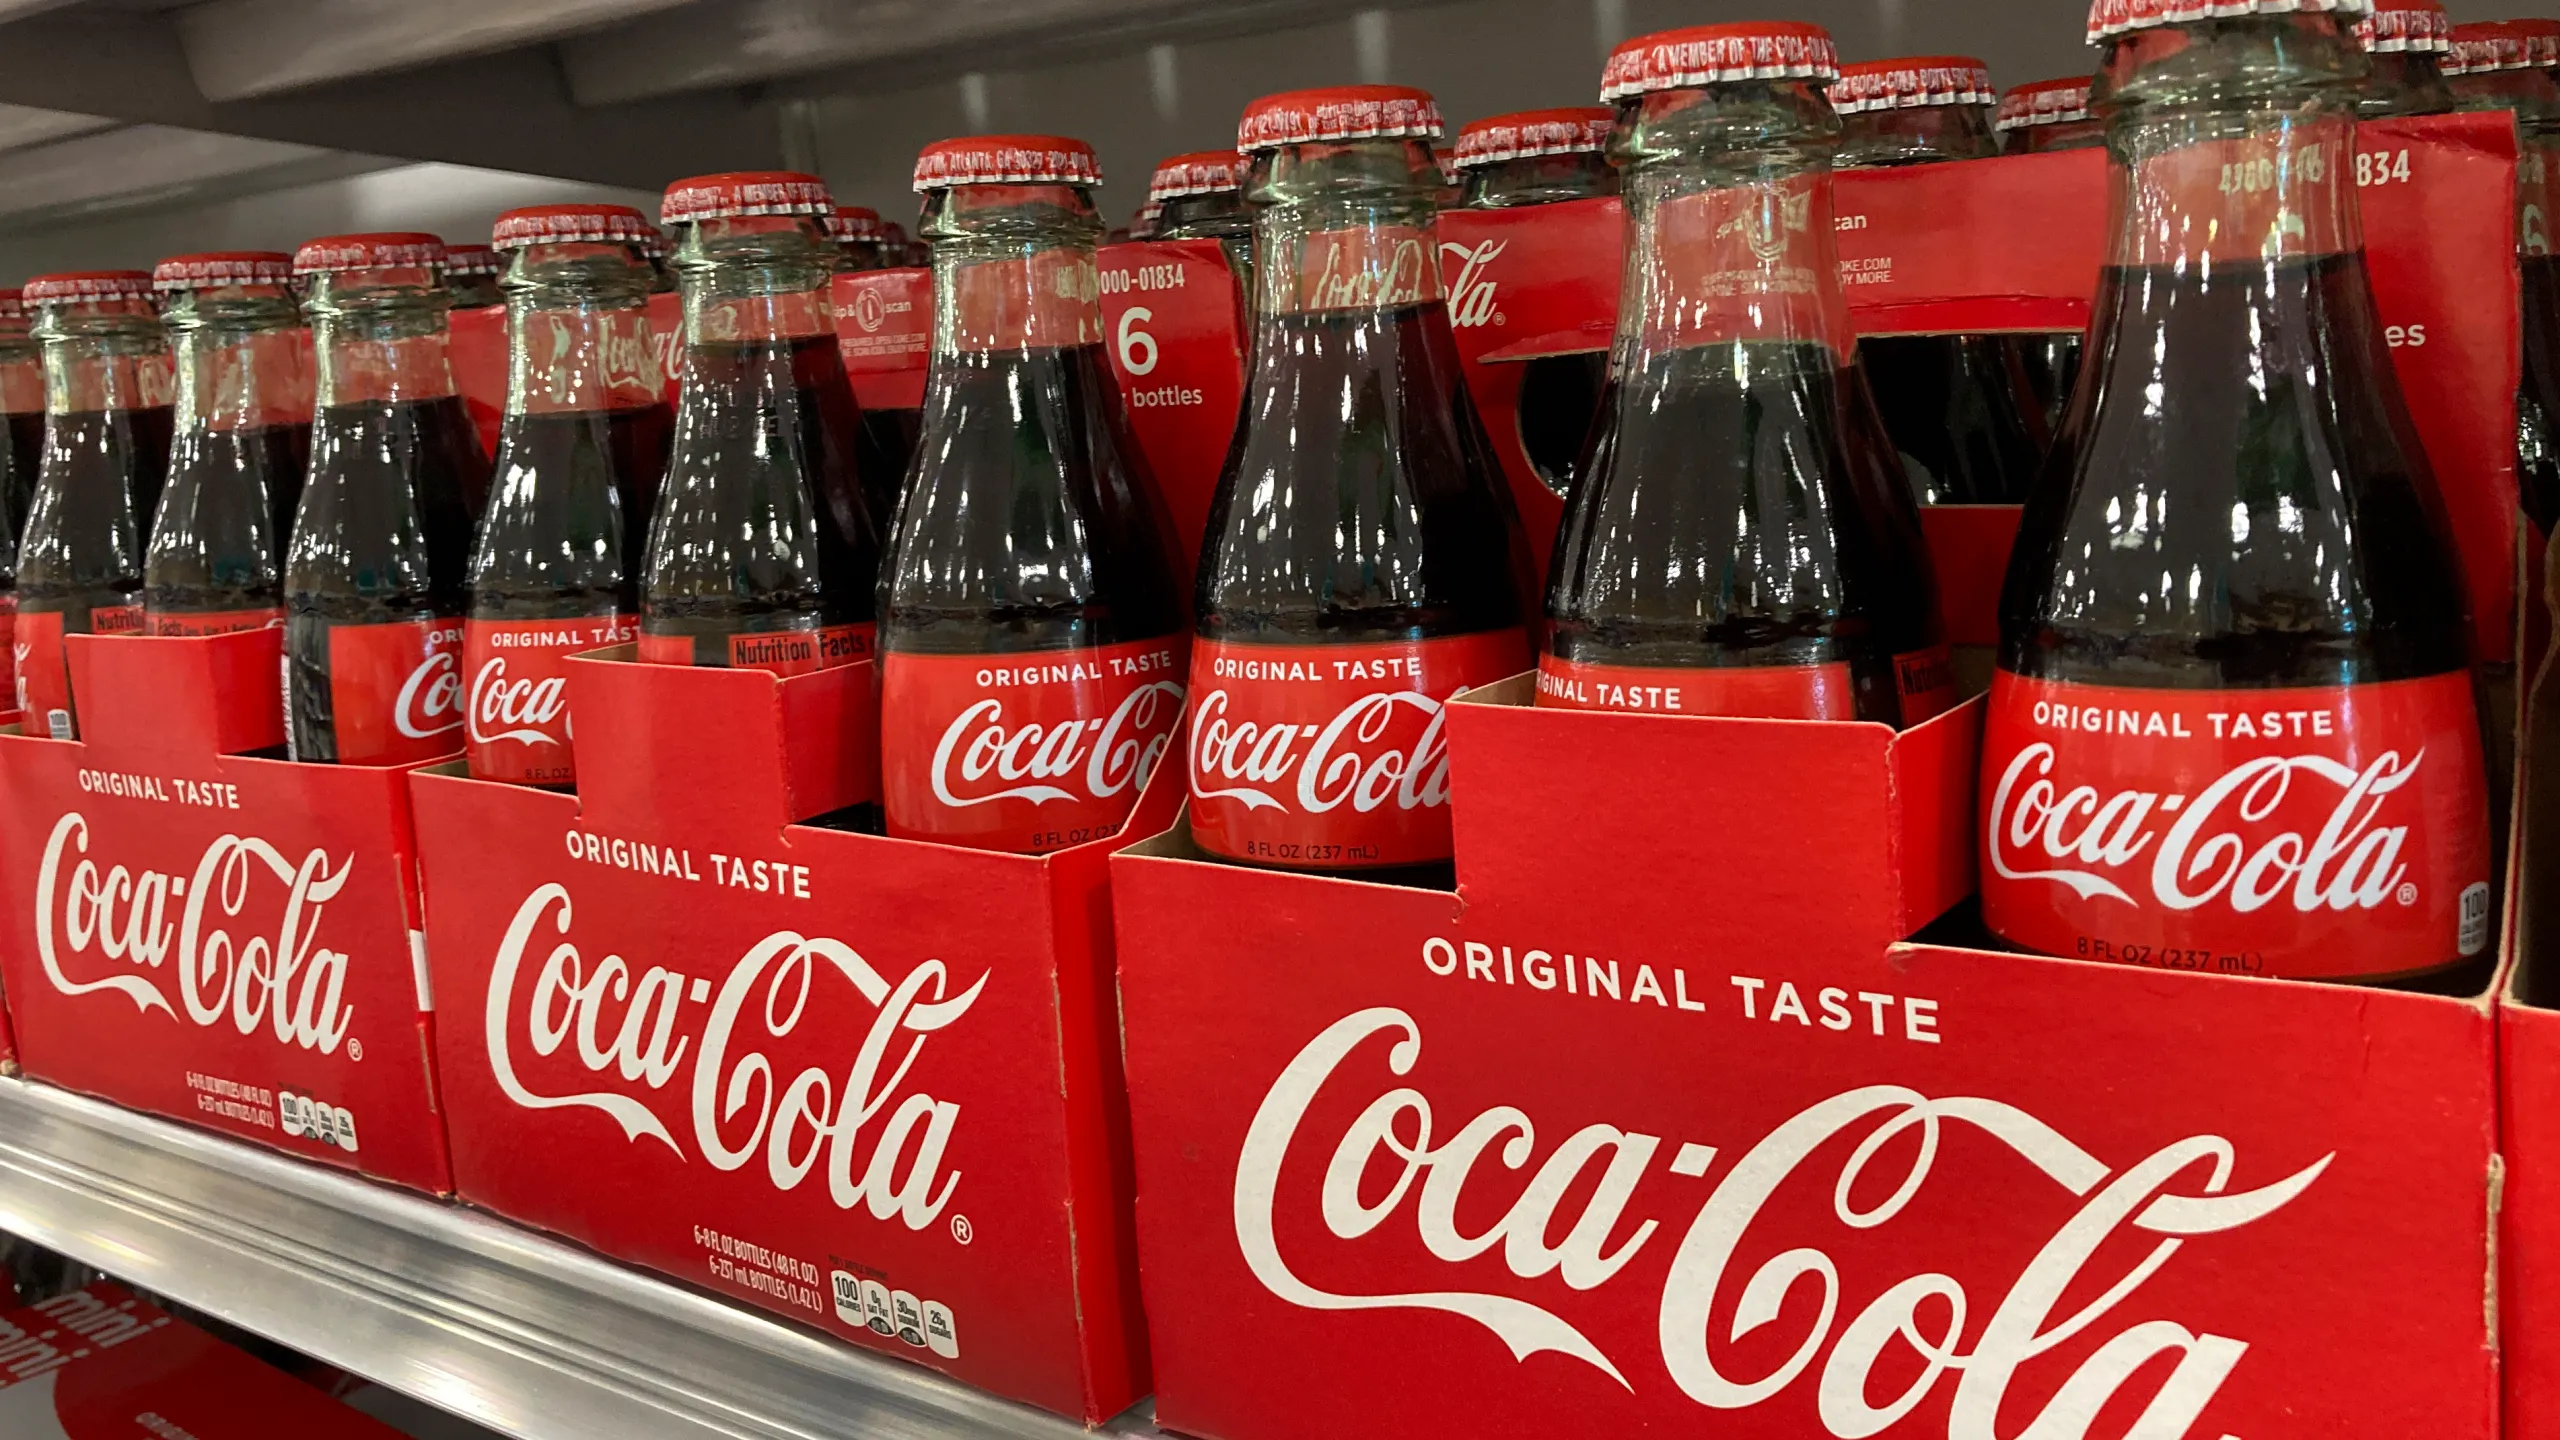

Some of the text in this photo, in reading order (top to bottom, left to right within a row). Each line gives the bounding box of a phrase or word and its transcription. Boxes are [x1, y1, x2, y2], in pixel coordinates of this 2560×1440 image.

[1669, 38, 1725, 68] MEMBER
[1729, 37, 1745, 64] OF
[1750, 36, 1771, 61] THE
[1855, 271, 1894, 284] MORE.
[832, 305, 847, 320] ip
[885, 301, 912, 313] scan
[1117, 306, 1158, 376] 6
[1132, 385, 1203, 407] bottles
[492, 625, 641, 647] ORIGINAL TAST
[736, 631, 865, 665] Nutrition Facts
[976, 650, 1171, 687] ORIGINAL TASTE
[1213, 656, 1422, 682] ORIGINAL TASTE
[1536, 669, 1681, 709] RIGINAL TASTE
[2033, 701, 2334, 738] ORIGINAL TASTE
[931, 681, 1188, 808] Coca-Co
[79, 768, 240, 809] ORIGINAL TASTE
[534, 769, 550, 780] FL
[553, 768, 570, 780] OZ
[1033, 824, 1121, 847] 8 FL OZ (23
[1989, 742, 2426, 913] Coca-Cola
[566, 830, 811, 899] ORIGINAL TASTE
[1247, 840, 1379, 860] 8 FL OZ (237 mL)
[36, 812, 354, 1054] Coca-Cola
[2076, 936, 2263, 972] 8 FL OZ (237 mL)
[1422, 936, 1941, 1044] ORIGINAL TASTE
[486, 882, 991, 1230] Coca-Cola
[1233, 1006, 2336, 1440] Coca-Cola
[694, 1225, 819, 1287] 6-8 FL OZ BOTTLES (48 FL OZ)
[735, 1267, 750, 1287] mL
[750, 1270, 788, 1300] BOTTLES
[835, 1276, 858, 1301] 100
[32, 1291, 171, 1349] mini
